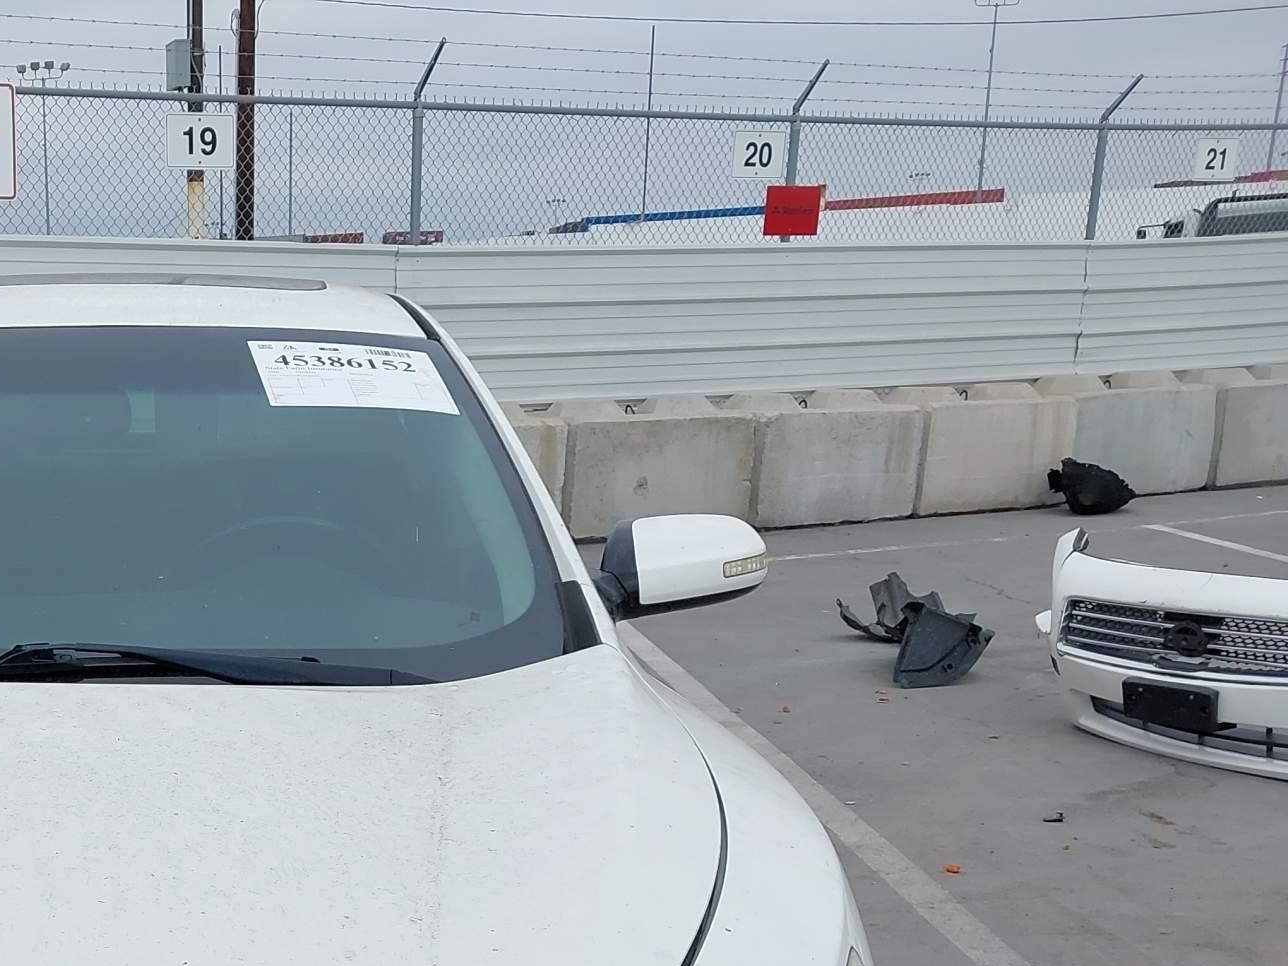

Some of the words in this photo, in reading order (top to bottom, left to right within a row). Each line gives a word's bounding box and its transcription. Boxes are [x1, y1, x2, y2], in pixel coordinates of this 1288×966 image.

[182, 126, 217, 156] 19
[743, 141, 773, 168] 20
[1204, 148, 1228, 170] 21
[274, 354, 416, 373] 45386152
